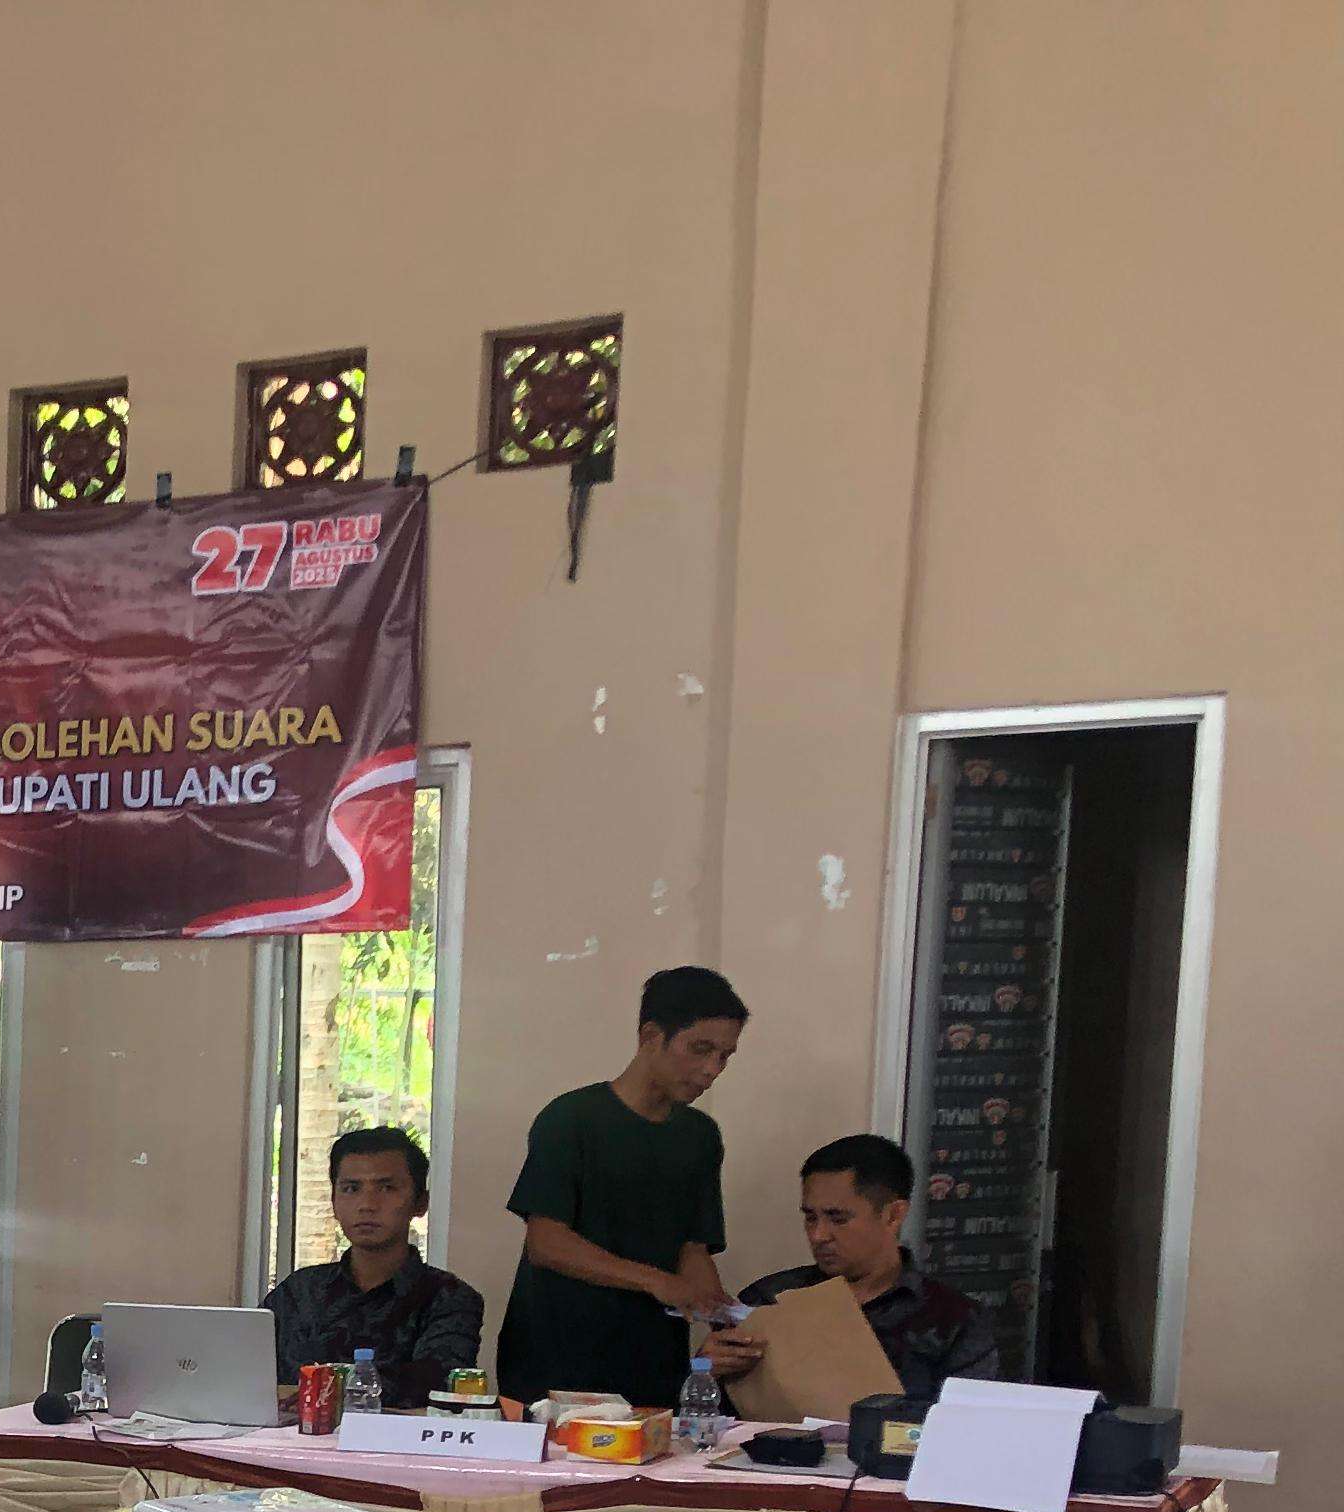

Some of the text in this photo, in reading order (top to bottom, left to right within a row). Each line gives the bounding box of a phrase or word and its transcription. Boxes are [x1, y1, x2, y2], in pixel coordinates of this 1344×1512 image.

[293, 513, 382, 547] RABU
[192, 521, 287, 596] 27
[294, 545, 375, 566] AGUSTUS
[185, 704, 343, 752] SUARA
[121, 762, 277, 809] ULANG
[421, 1429, 476, 1444] PPK
